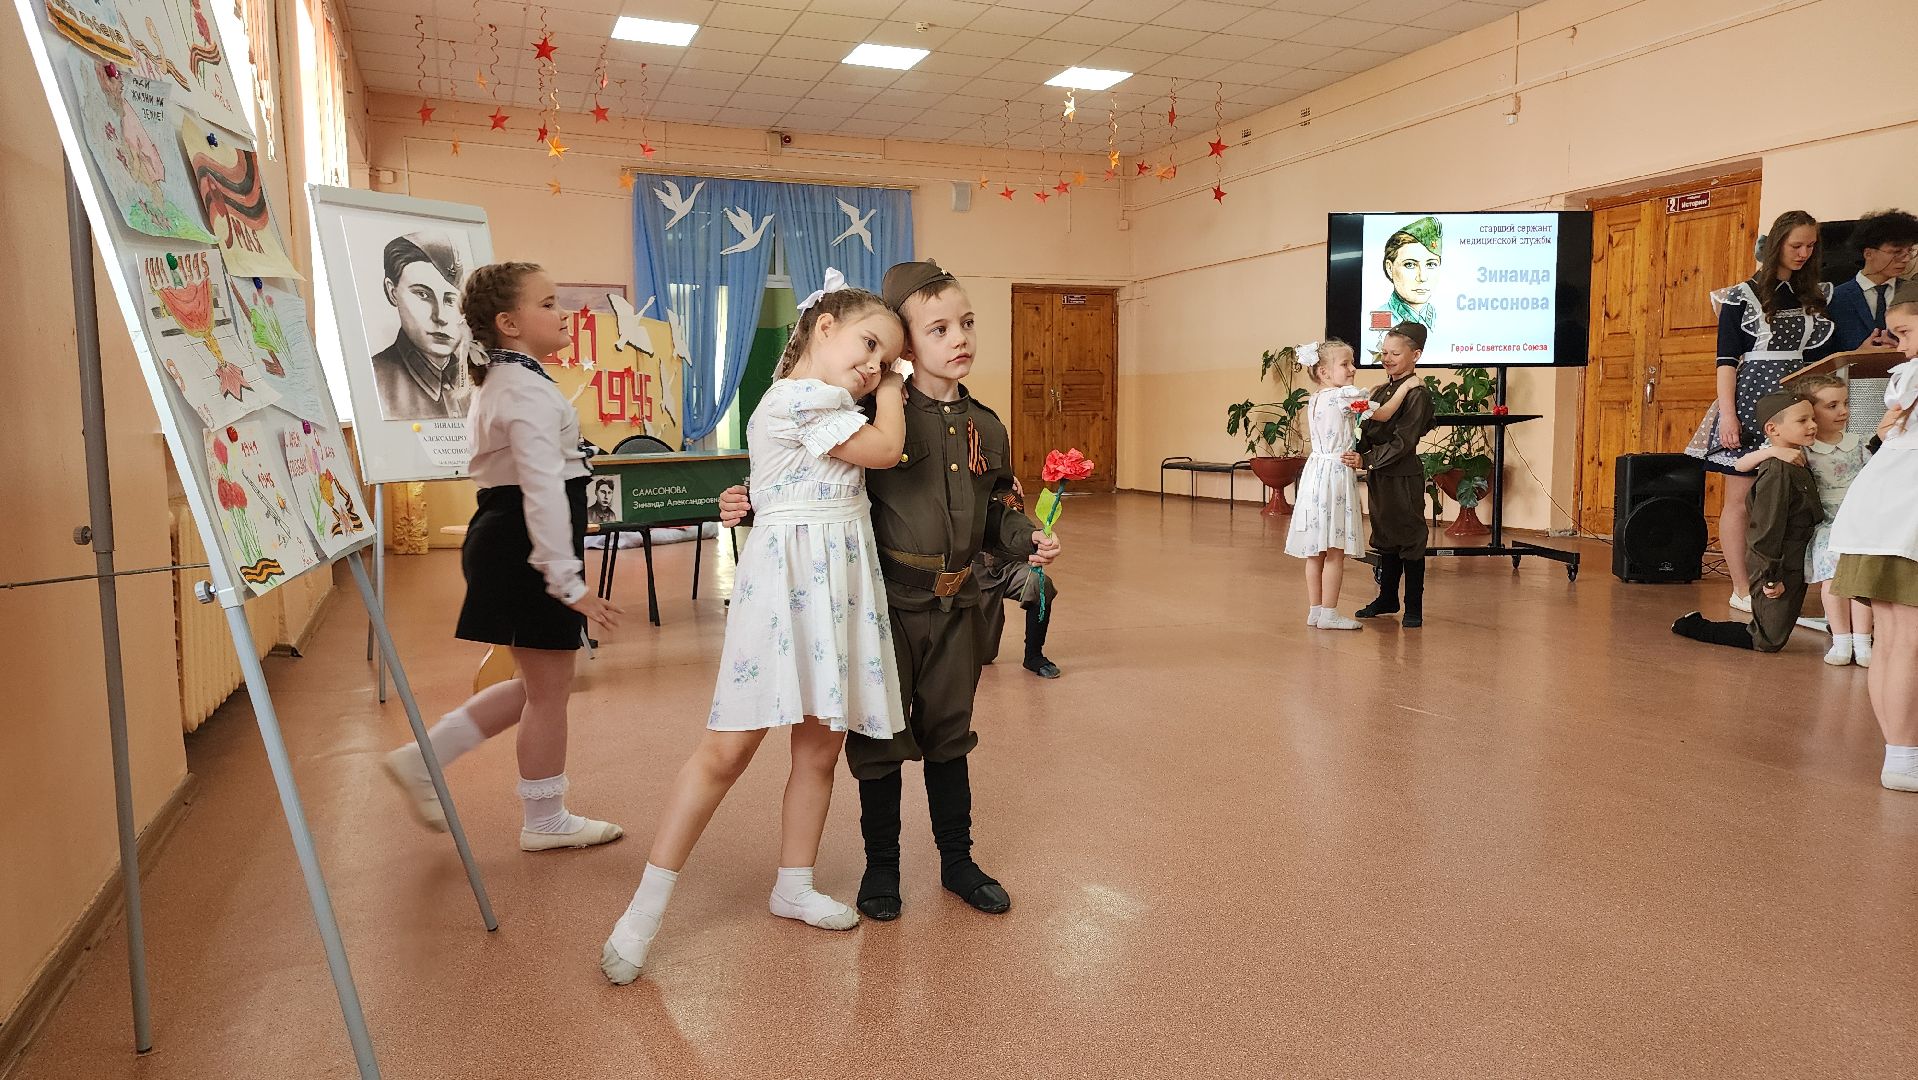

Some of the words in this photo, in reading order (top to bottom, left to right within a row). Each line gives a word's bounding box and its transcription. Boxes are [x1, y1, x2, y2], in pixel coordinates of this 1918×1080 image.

[1669, 198, 1676, 212] 2
[1681, 199, 1708, 209] Истории
[1479, 224, 1515, 234] старший
[1517, 225, 1552, 234] сержант
[1459, 236, 1517, 246] медицинской
[1519, 236, 1552, 246] службы
[1476, 266, 1551, 285] Зинаида
[1456, 293, 1550, 311] Самсонова
[1451, 343, 1474, 353] Герой
[1476, 343, 1521, 352] Советского
[1522, 342, 1548, 351] Союза
[588, 370, 653, 423] 1945
[632, 486, 687, 497] САМСОНОВА
[633, 500, 665, 510] Зинаида
